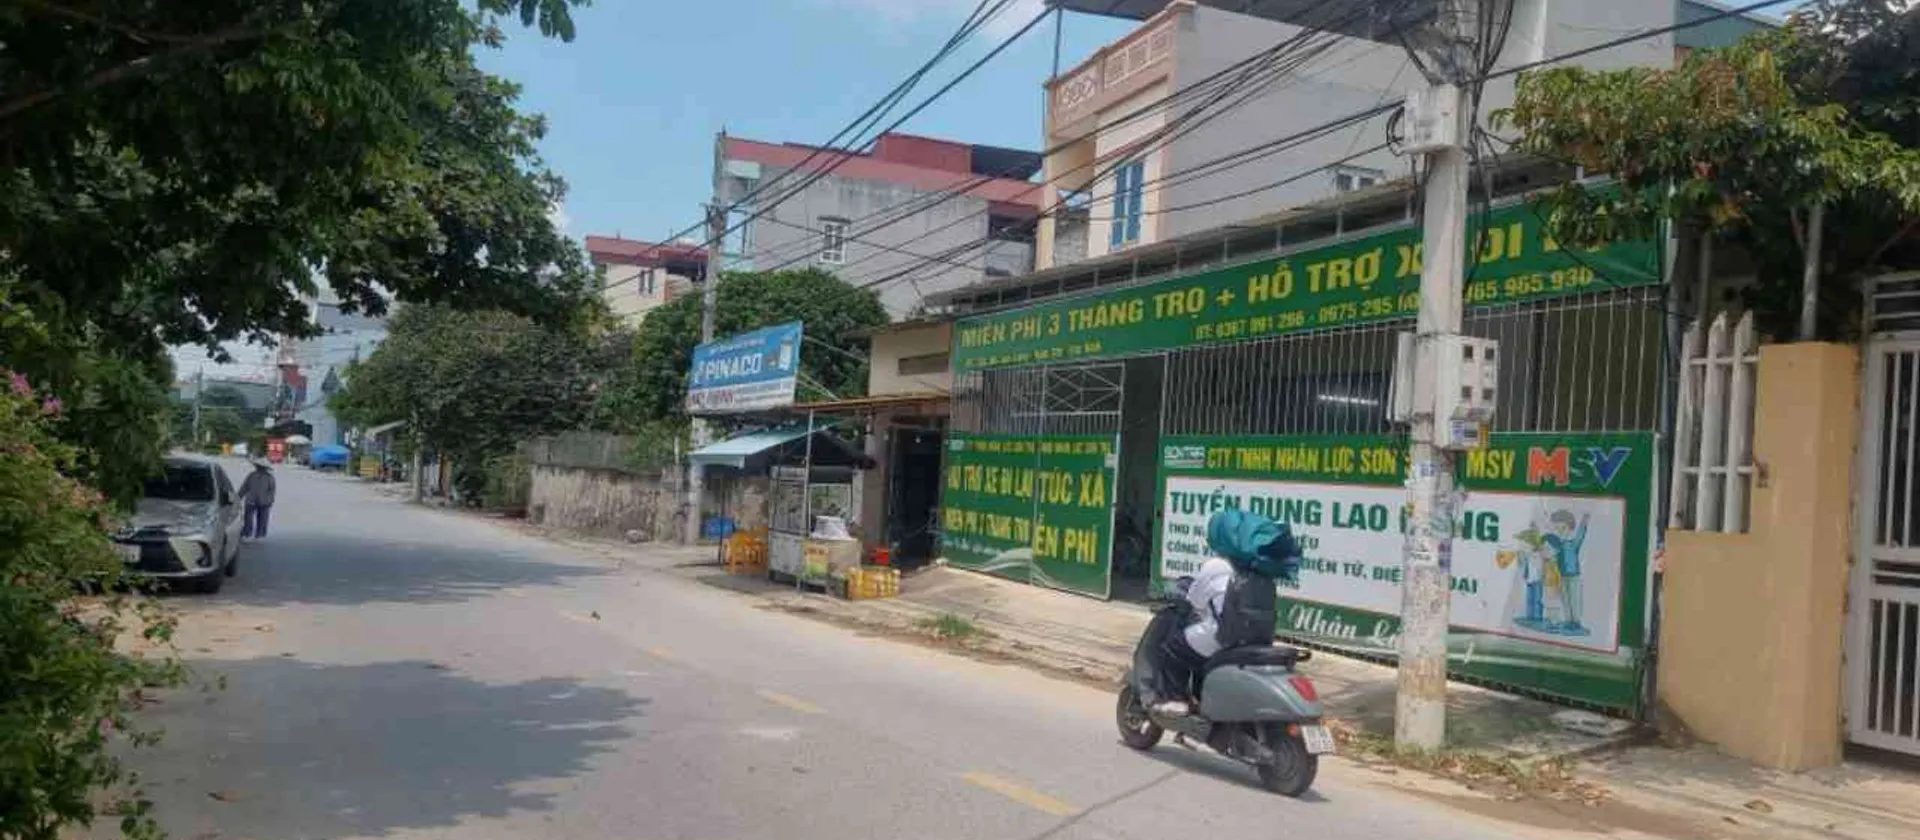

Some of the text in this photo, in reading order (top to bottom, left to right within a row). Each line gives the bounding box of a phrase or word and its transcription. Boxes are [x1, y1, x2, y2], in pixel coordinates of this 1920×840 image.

[1047, 312, 1061, 336] 3
[1152, 287, 1205, 319] TRỌ
[1305, 246, 1383, 293] TRỢ
[706, 353, 763, 379] PINACO
[1206, 447, 1231, 470] CTY
[1276, 443, 1319, 473] NHÂN
[1361, 446, 1398, 476] SƠN
[1466, 449, 1515, 479] MSV
[1332, 502, 1388, 531] LAO
[1372, 564, 1403, 585] ĐIỆ
